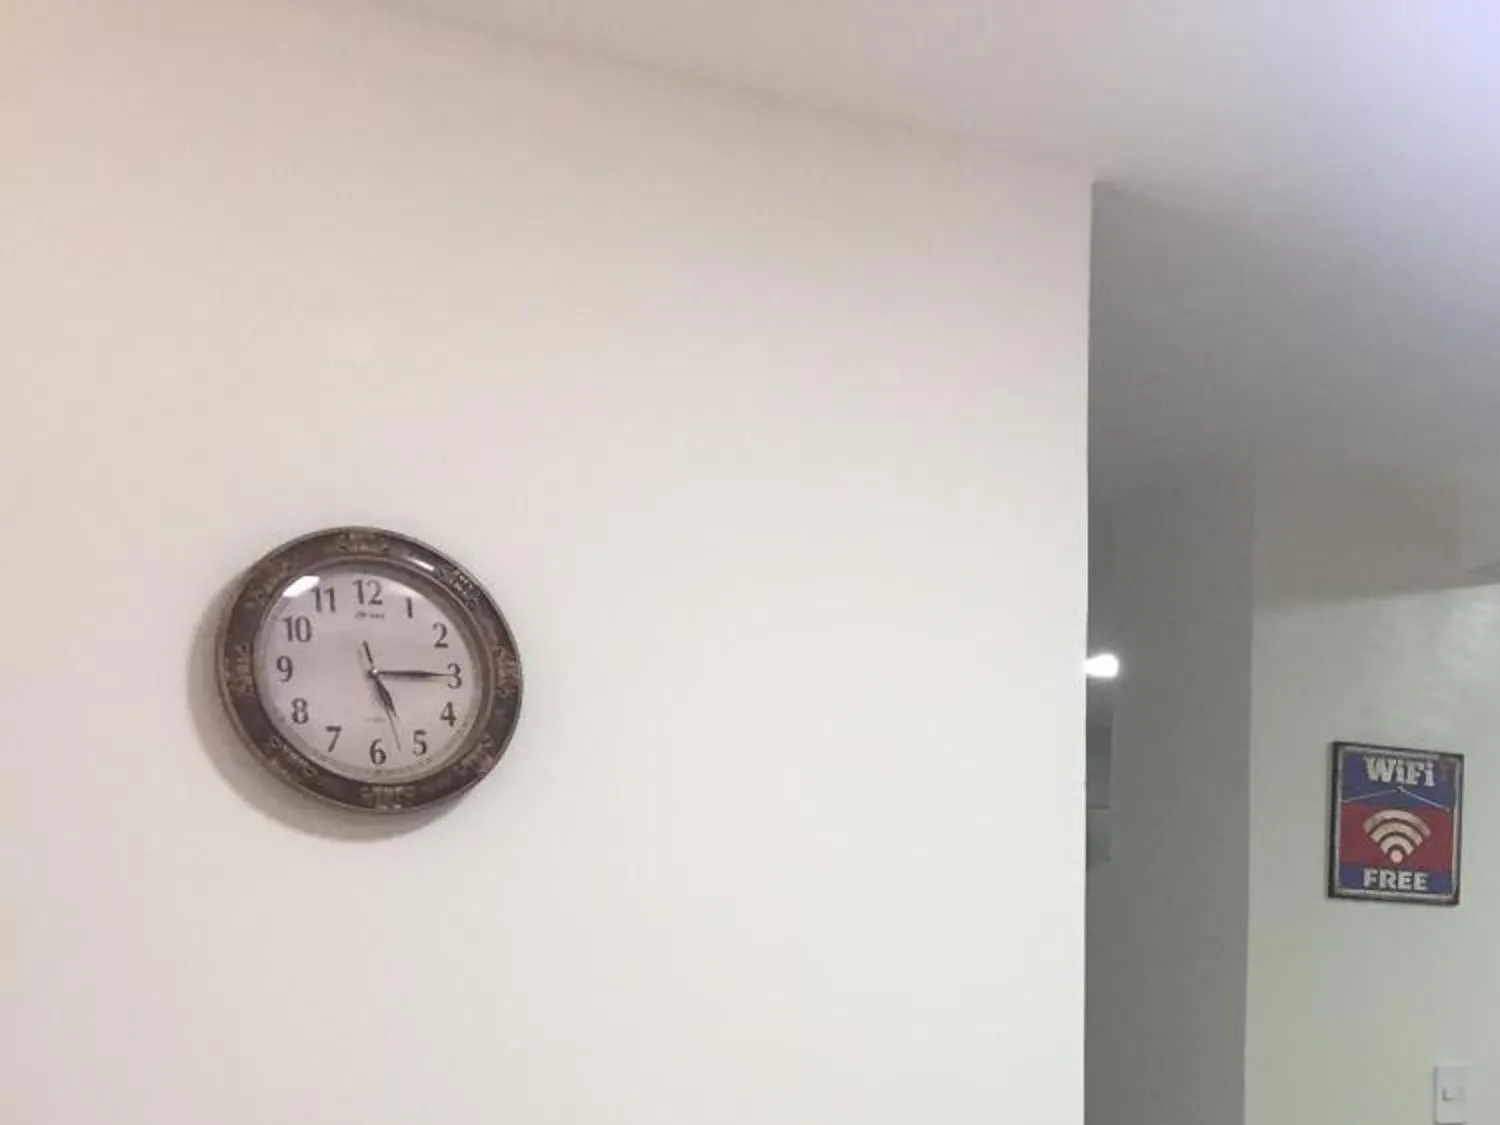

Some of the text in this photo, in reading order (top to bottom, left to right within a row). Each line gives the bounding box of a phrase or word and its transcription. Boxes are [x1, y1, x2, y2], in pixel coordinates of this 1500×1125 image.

[311, 586, 337, 613] 11
[352, 579, 383, 606] 12
[405, 597, 414, 619] 1
[283, 615, 312, 643] 10
[432, 622, 449, 649] 2
[276, 655, 293, 683] 9
[447, 663, 463, 689] 3
[291, 697, 309, 725] 8
[439, 701, 457, 727] 4
[325, 725, 342, 752] 7
[369, 738, 387, 766] 6
[412, 730, 427, 756] 5
[1364, 755, 1436, 787] WiFi
[1363, 868, 1430, 891] FREE
